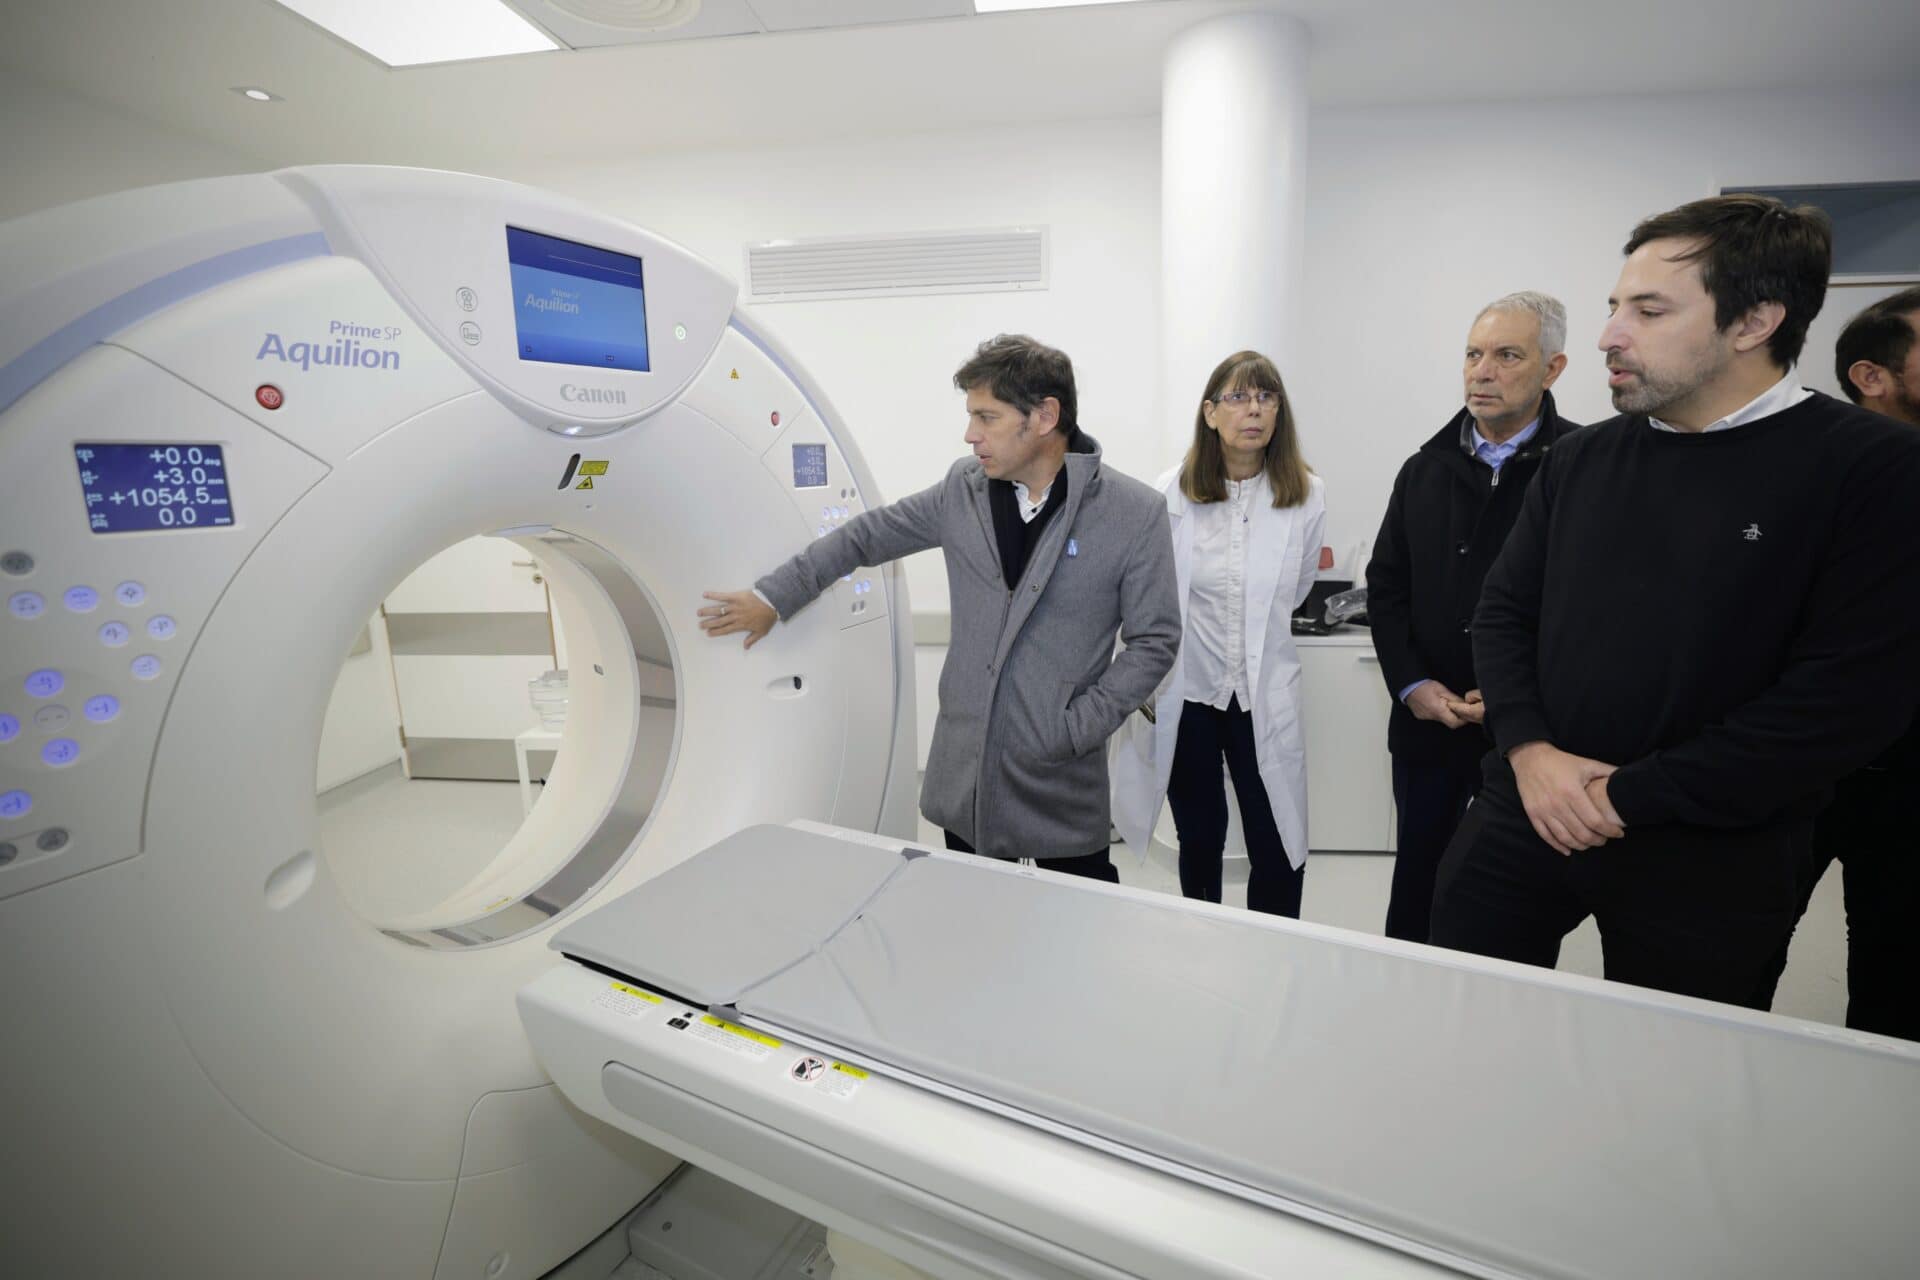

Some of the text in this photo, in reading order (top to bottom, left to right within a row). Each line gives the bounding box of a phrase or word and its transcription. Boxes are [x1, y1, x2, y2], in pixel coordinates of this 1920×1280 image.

[524, 293, 579, 314] Aquilion
[330, 320, 401, 340] Prime SP
[256, 333, 400, 371] Aquilion
[560, 383, 626, 404] Canon
[150, 447, 202, 465] +0.0
[154, 467, 206, 485] +3.0
[110, 487, 210, 507] +1054.5
[159, 507, 196, 525] 0.0
